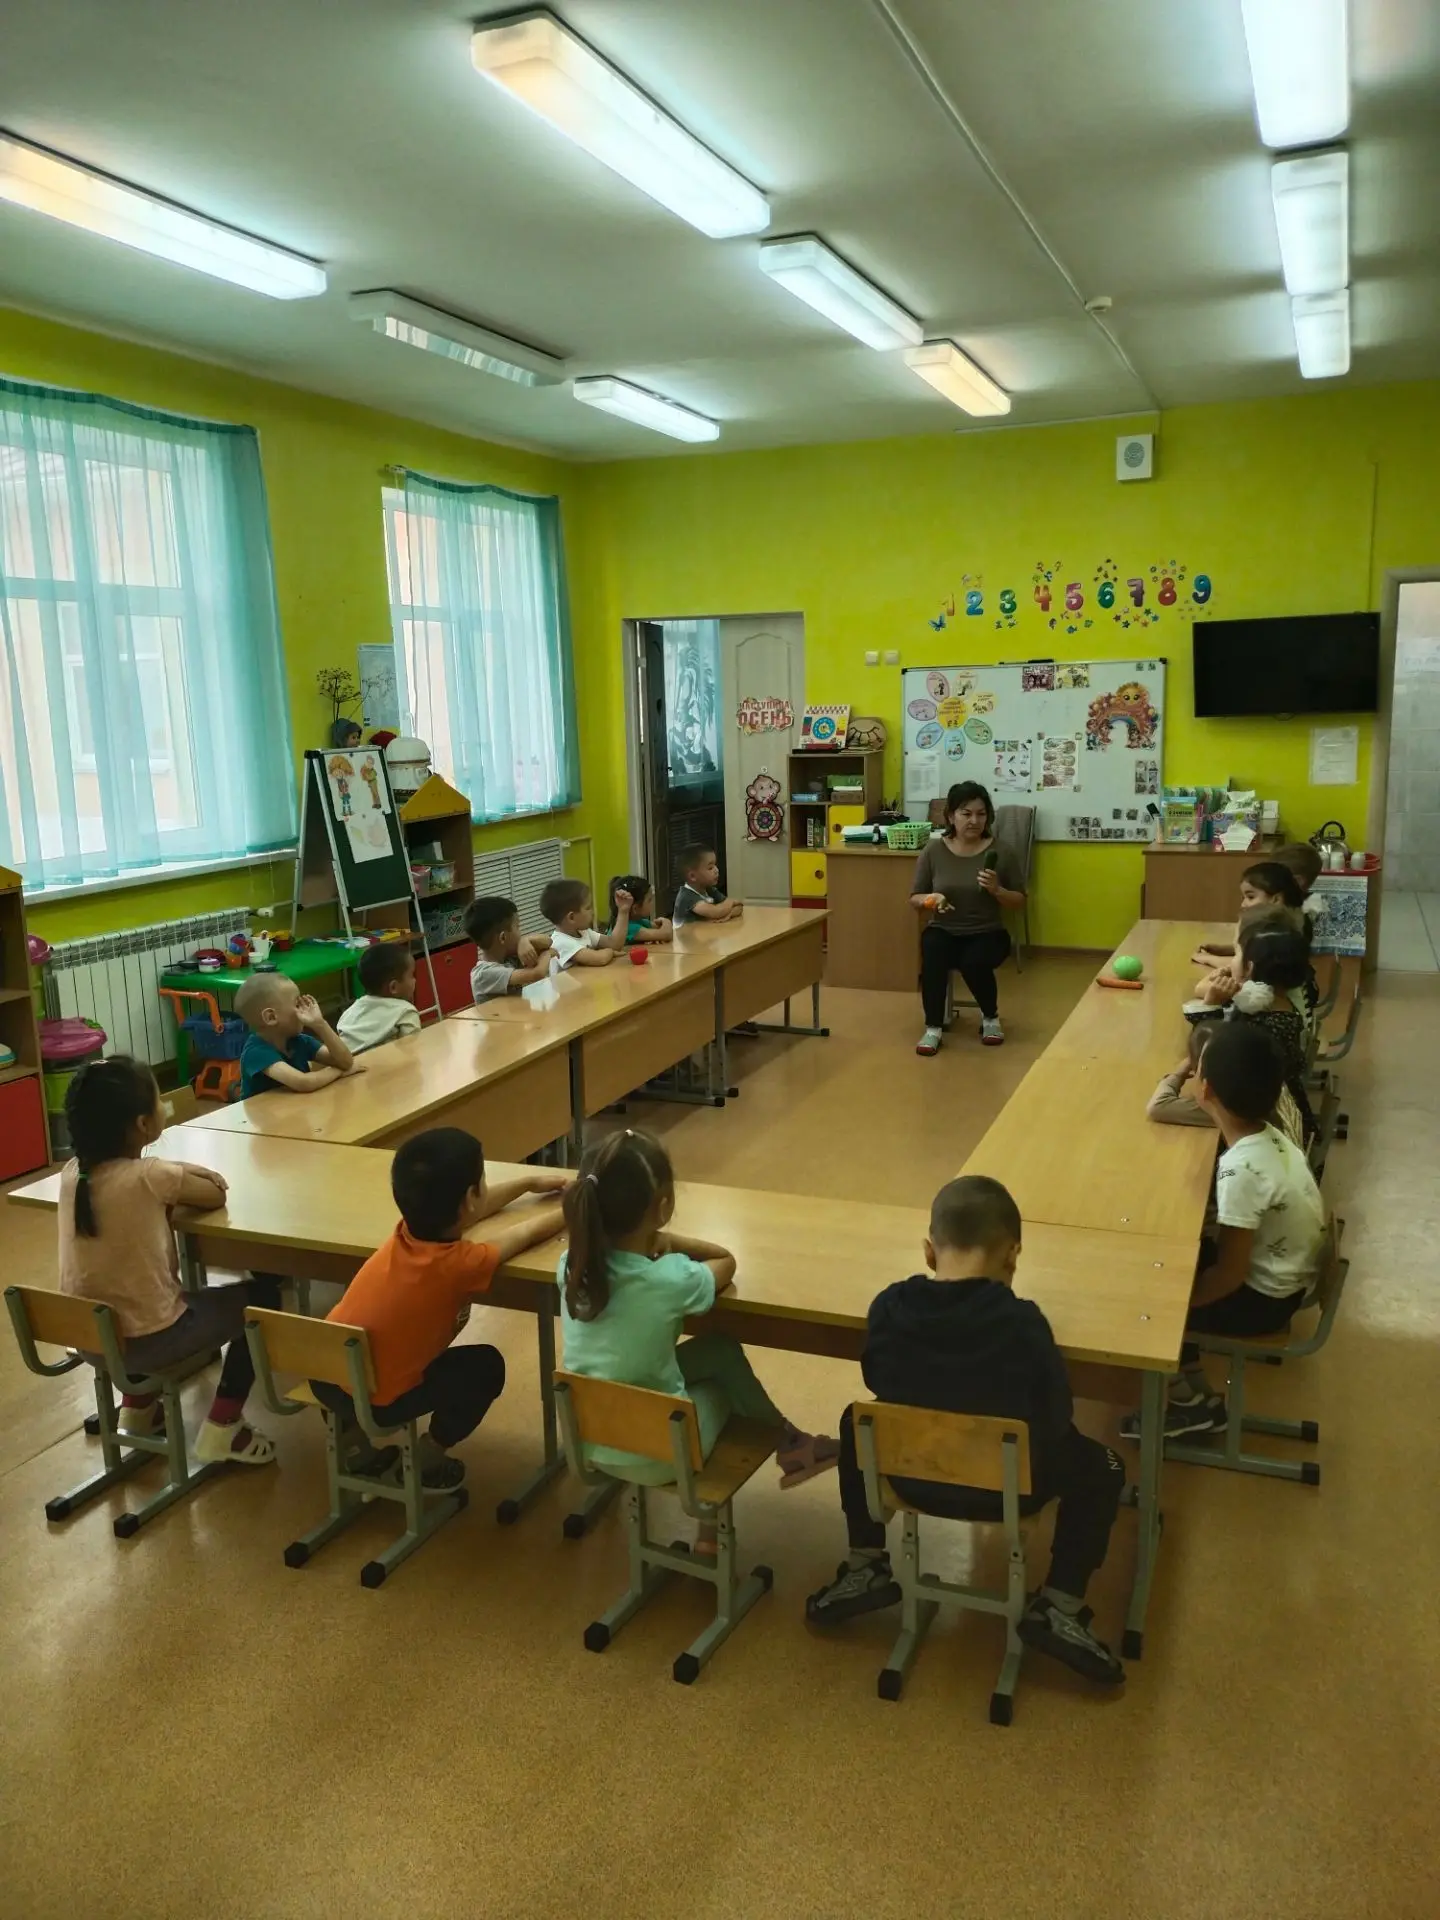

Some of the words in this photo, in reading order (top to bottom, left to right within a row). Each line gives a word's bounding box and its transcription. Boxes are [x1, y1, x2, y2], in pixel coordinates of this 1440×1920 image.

[965, 591, 984, 616] 2
[999, 589, 1017, 614] 3
[1034, 584, 1052, 612] 4
[1065, 583, 1084, 610] 5
[1097, 581, 1115, 609] 6
[1127, 578, 1144, 607] 7
[1158, 577, 1177, 606] 8
[1192, 574, 1212, 604] 9
[738, 710, 792, 729] ОСЕНЬ
